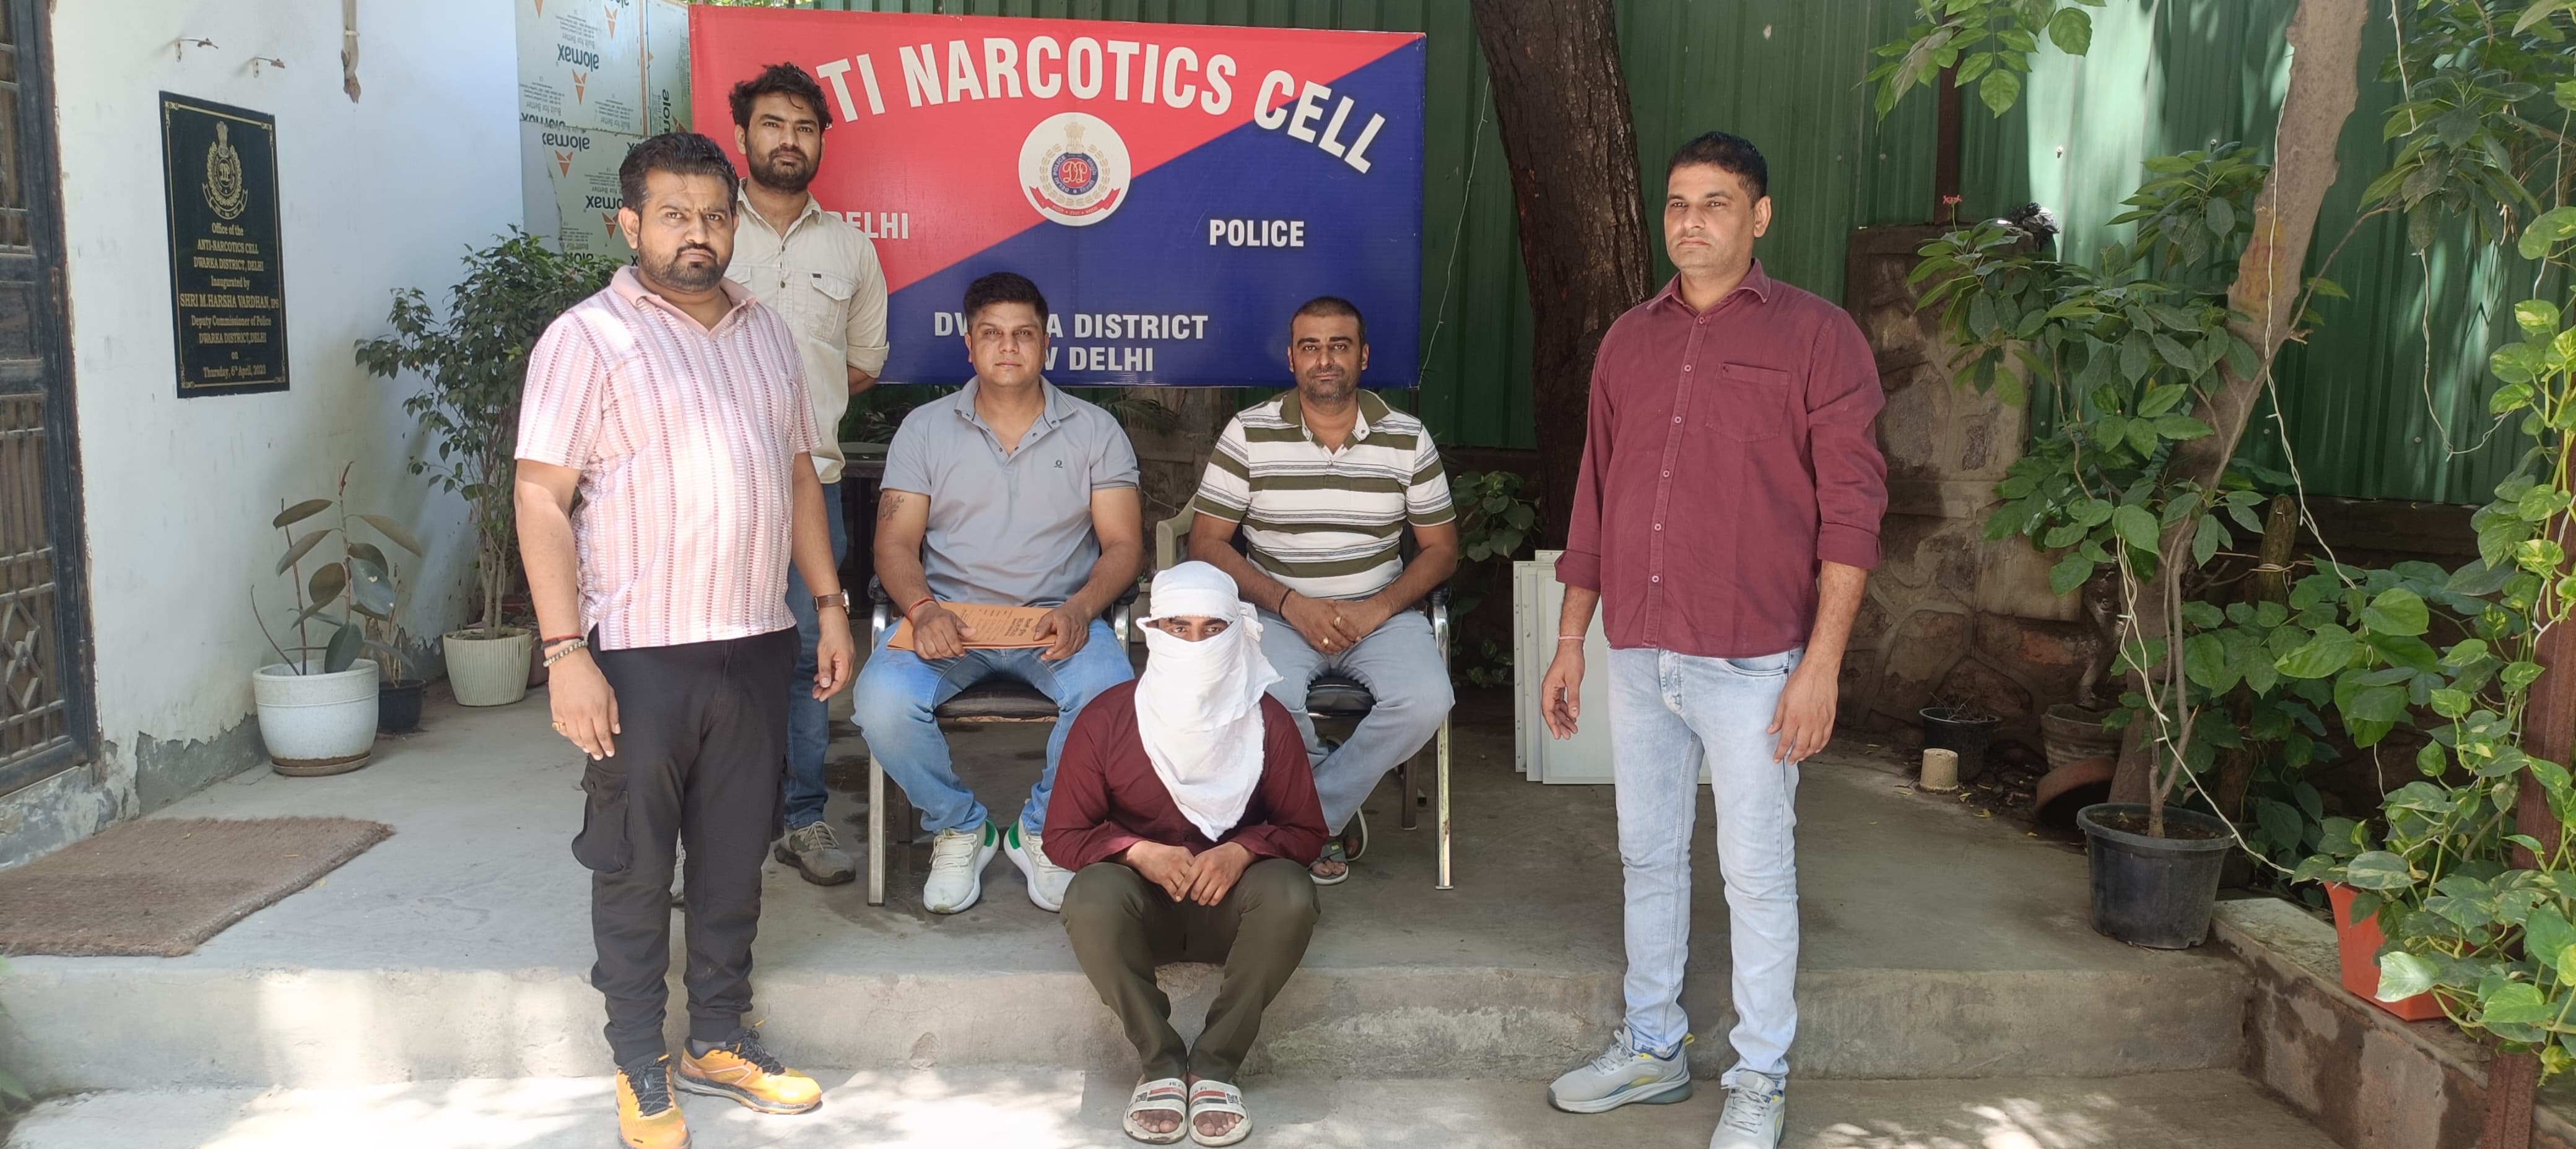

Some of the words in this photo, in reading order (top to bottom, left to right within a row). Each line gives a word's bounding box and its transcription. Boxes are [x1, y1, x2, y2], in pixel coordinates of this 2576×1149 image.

[557, 43, 599, 72] alomax
[662, 89, 671, 133] alom
[899, 35, 1237, 115] NARCOTICS
[1254, 69, 1385, 174] CELL
[585, 195, 624, 210] omax
[212, 222, 228, 235] Office
[228, 224, 235, 235] of
[235, 225, 244, 236] the
[1209, 219, 1305, 247] POLICE
[198, 238, 245, 254] ANTI-NARCOTICS
[245, 243, 259, 254] CELL
[193, 256, 219, 269] DWARKA
[219, 258, 247, 272] DISTRICT,
[247, 261, 264, 272] DELHI
[211, 275, 243, 290] Inaugurated
[243, 277, 250, 290] by
[180, 293, 199, 307] SHRI
[199, 294, 237, 308] M.HARSHA
[238, 295, 271, 310] VARDHAN,
[271, 298, 279, 308] IPS
[191, 314, 212, 329] Deputy
[212, 314, 250, 326] Commissioner
[250, 315, 256, 326] of
[256, 315, 271, 326] Police
[1074, 314, 1209, 339] DISTRICT
[199, 332, 224, 344] DWARKA
[231, 352, 239, 360] on
[1069, 347, 1154, 371] DELHI
[203, 366, 230, 379] Thursday,
[239, 365, 253, 378] April,
[253, 365, 266, 375] 2023
